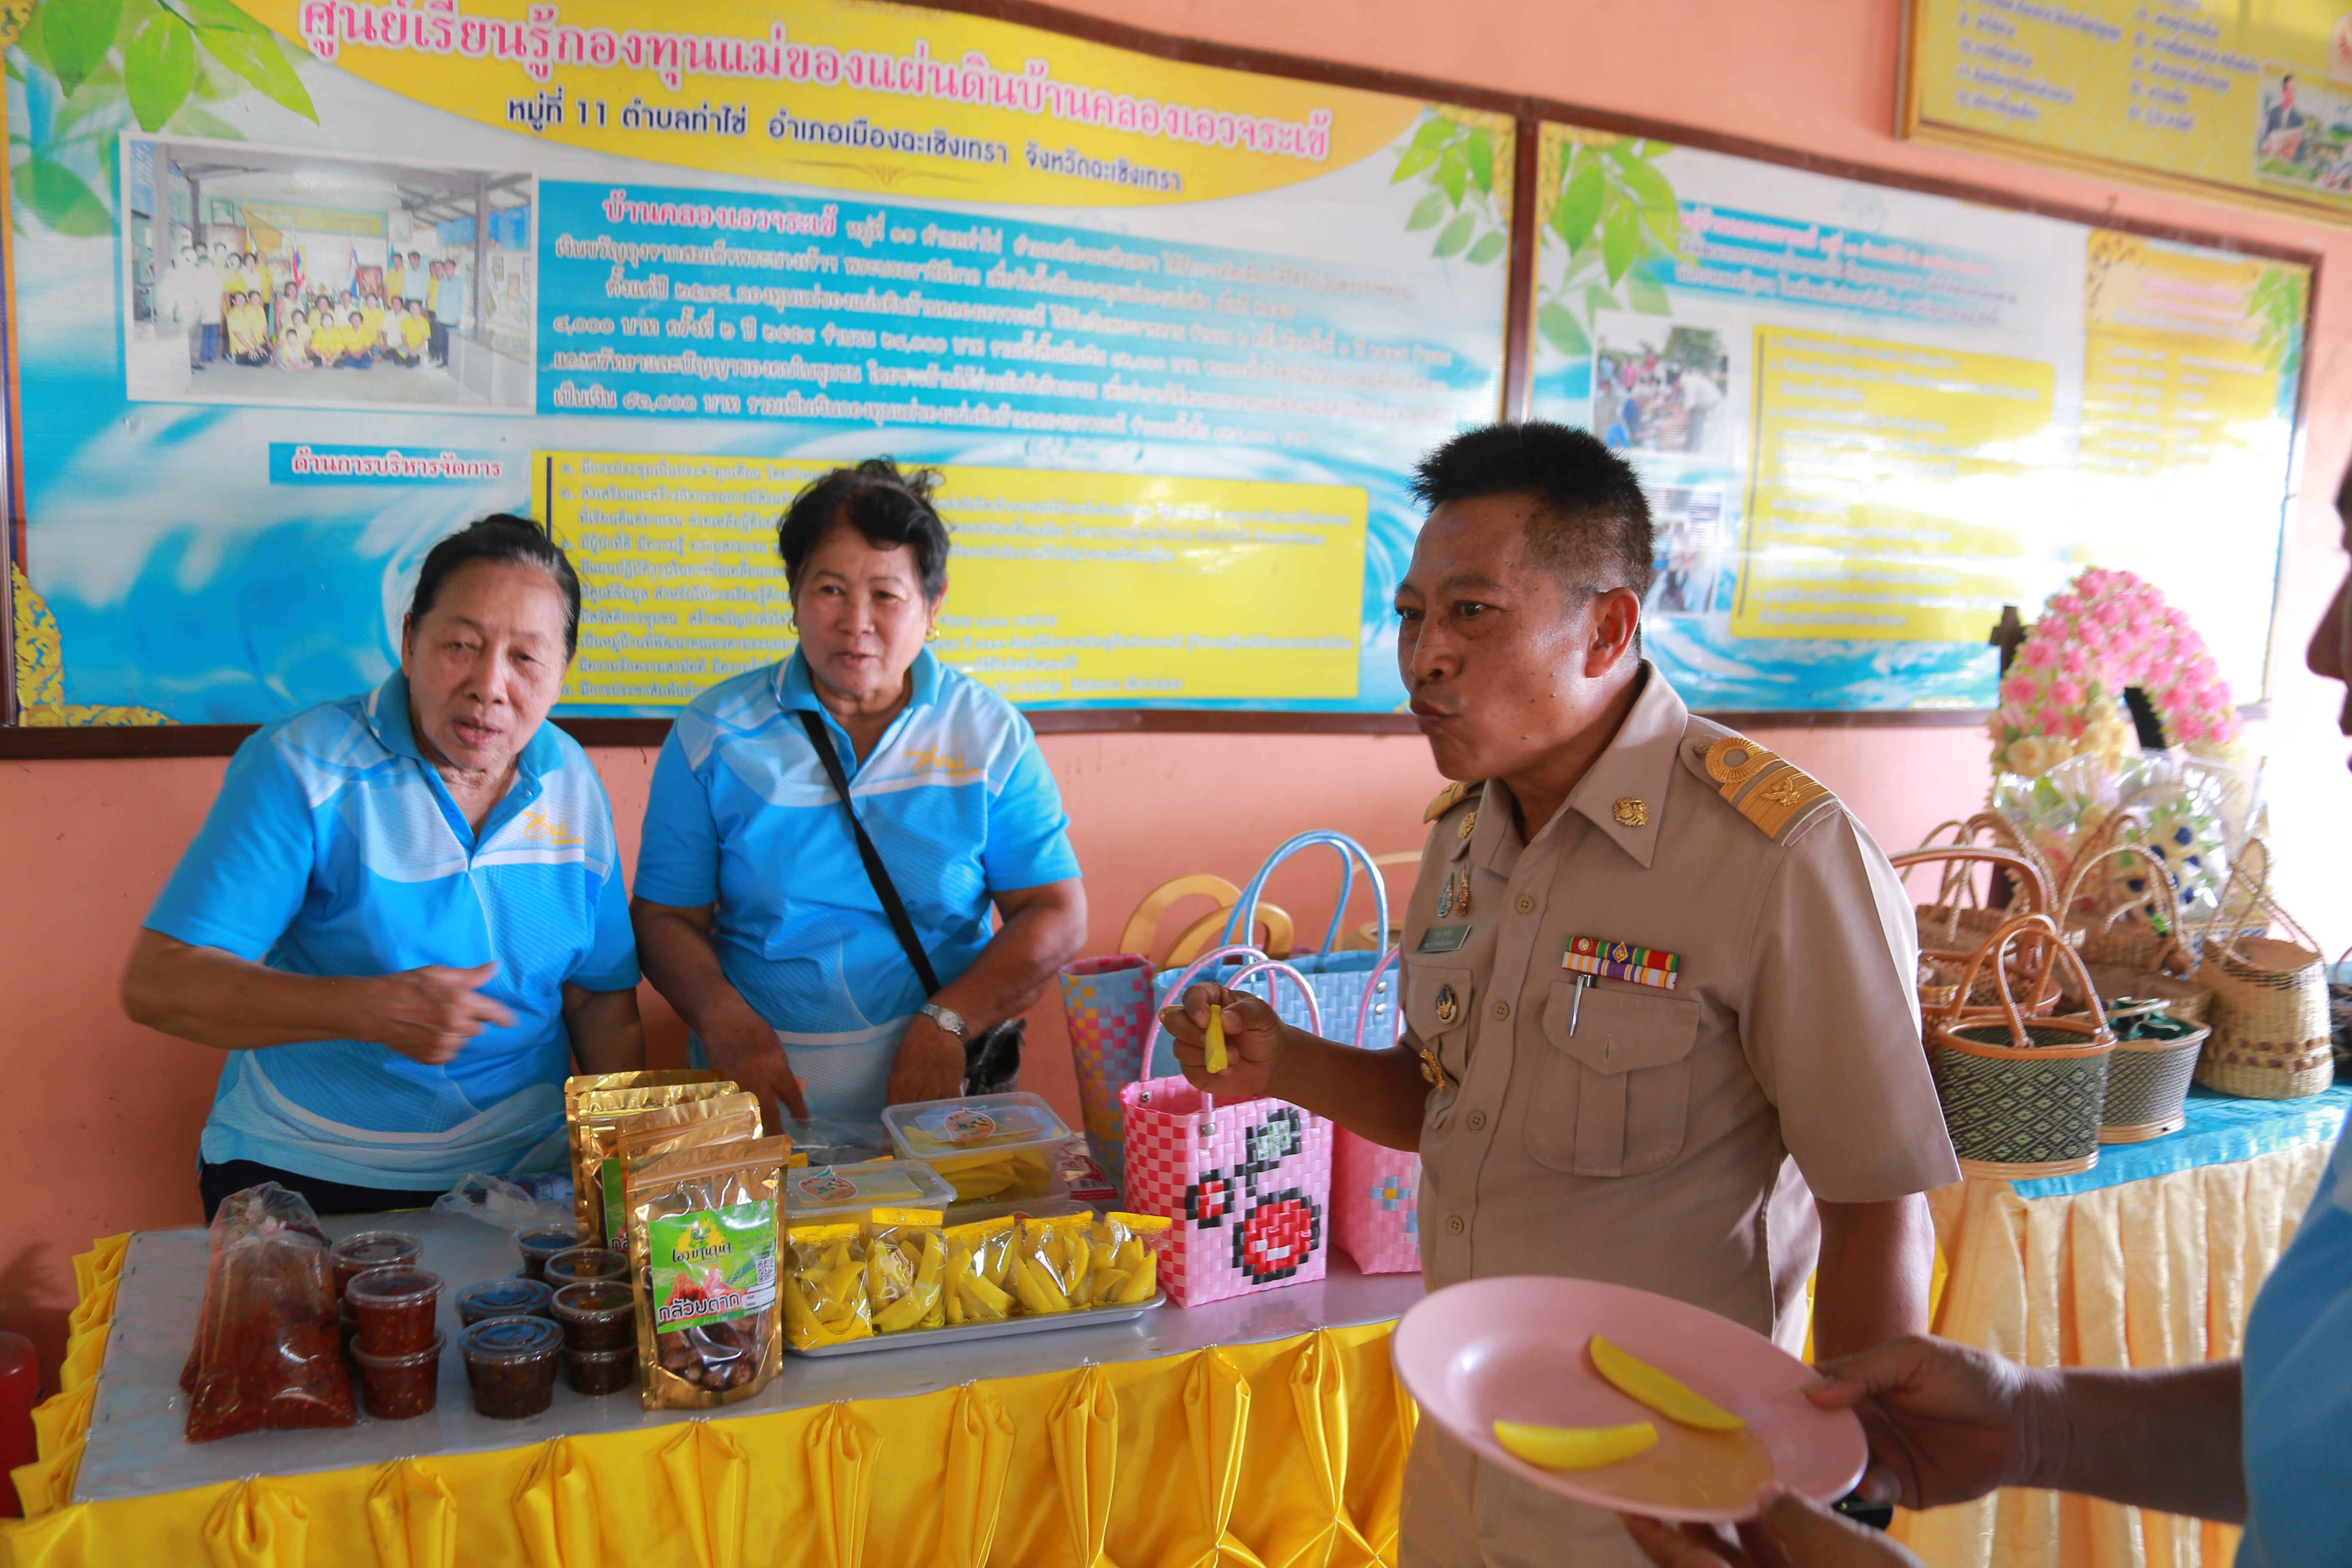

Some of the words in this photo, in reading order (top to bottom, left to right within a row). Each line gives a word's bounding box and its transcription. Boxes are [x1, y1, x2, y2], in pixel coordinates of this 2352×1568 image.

[303, 0, 1331, 159] ศูนย์เรียนรู้กองทุนแม่ของแผ่นดินบ้านคลองเอวจระเข้
[508, 87, 564, 132] หมู่ที่
[578, 100, 607, 126] 11
[622, 105, 747, 135] ตำบลท่าไข่
[769, 109, 1008, 165] อำเภอเมืองฉะเชิงเทรา
[1025, 140, 1182, 193] จังหวัดฉะเชิงเทรา
[603, 189, 838, 237] บ้านคลองเอวจระเข้
[846, 211, 885, 248] หมู่ที่
[890, 227, 917, 245] ๑๑
[605, 265, 669, 300] ตั้งแต่ปี
[621, 317, 660, 337] บาท
[665, 306, 714, 339] ครั้งที่
[720, 321, 735, 340] ๒
[741, 315, 756, 342] ปี
[821, 321, 876, 349] จำนวน
[952, 336, 986, 357] บาท
[554, 380, 617, 409] เป็นเงิน
[703, 393, 741, 414] บาท
[291, 445, 504, 478] ด้านการบริหารจัดการ
[689, 609, 794, 629] สร้างขวัญกำลังใจ
[659, 1292, 740, 1323] กล้วยตาก
